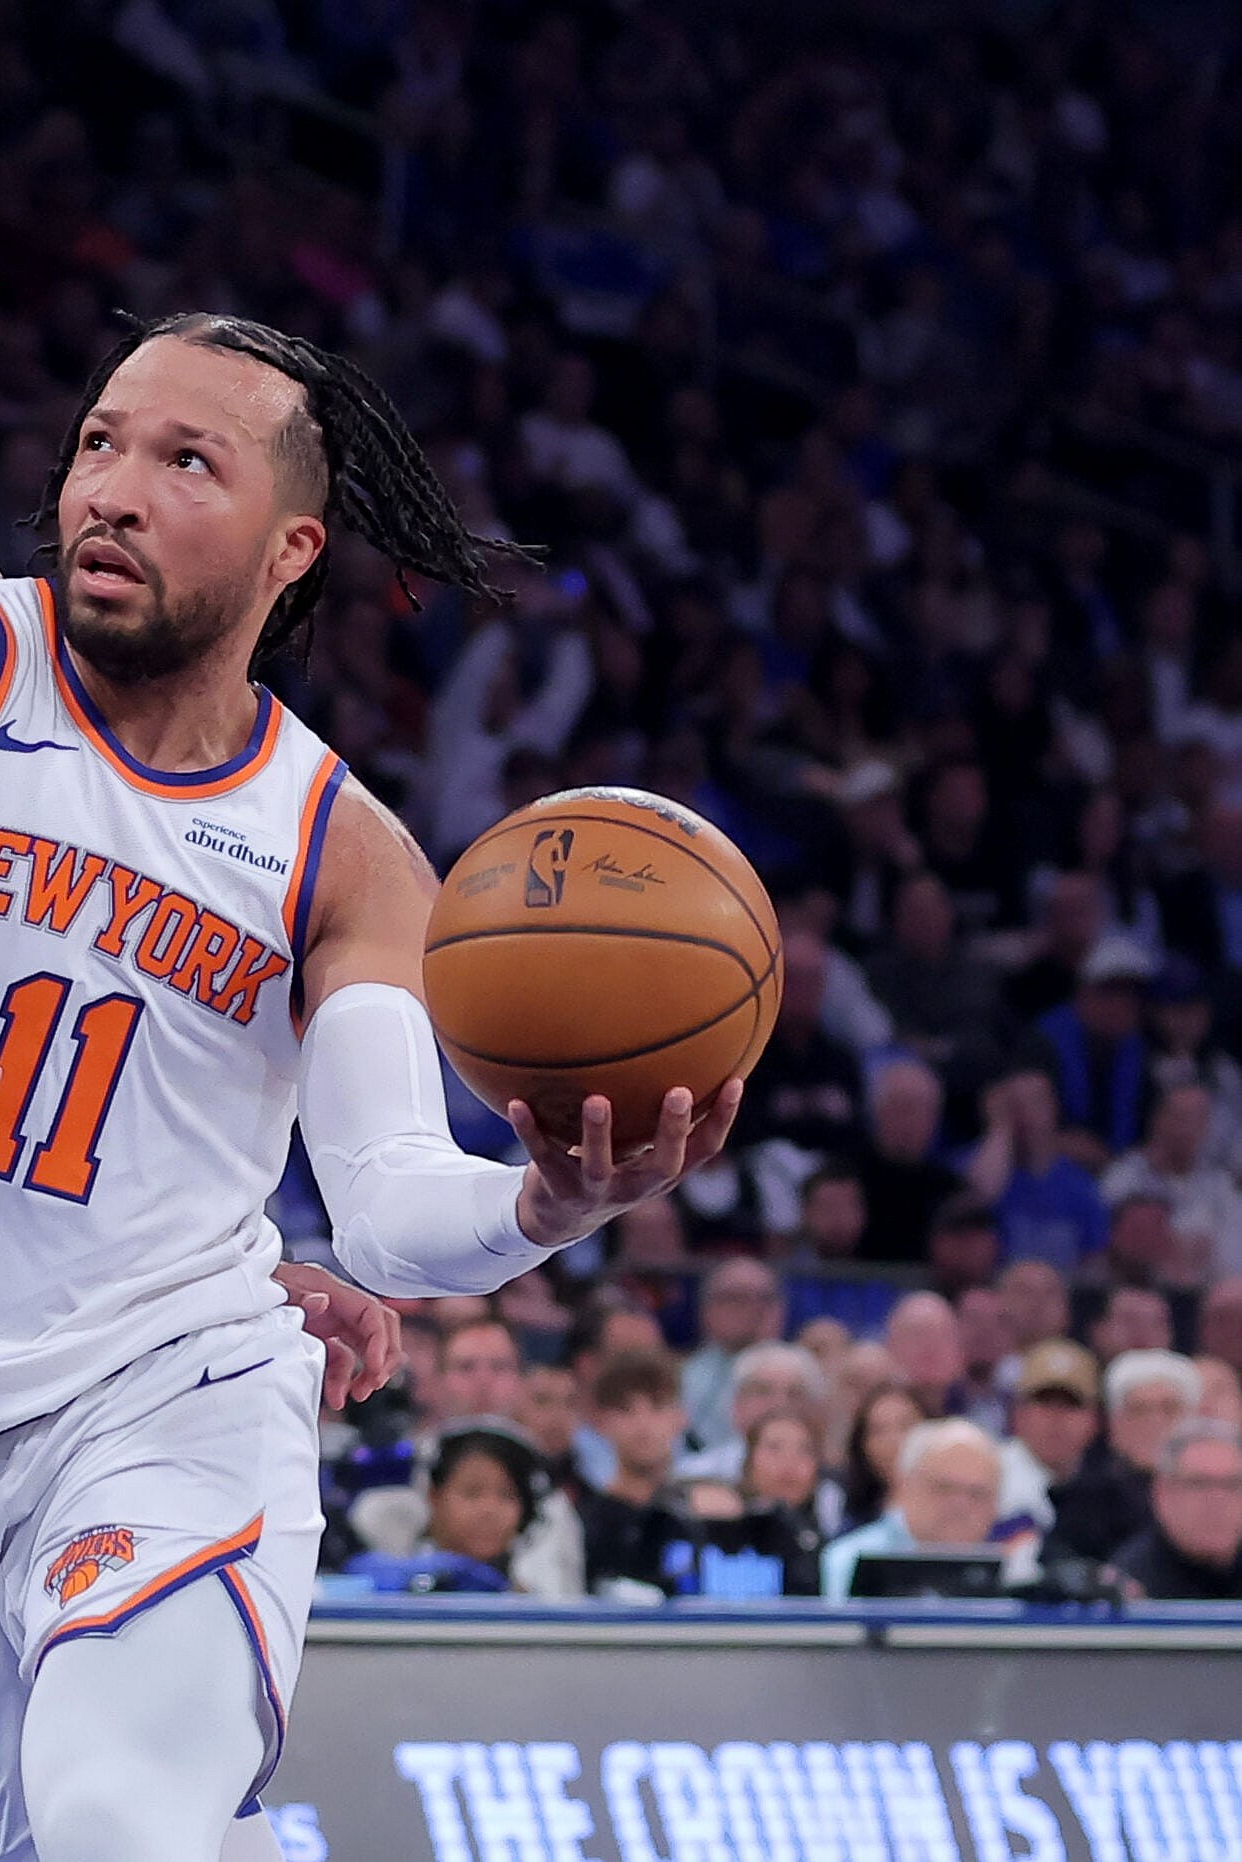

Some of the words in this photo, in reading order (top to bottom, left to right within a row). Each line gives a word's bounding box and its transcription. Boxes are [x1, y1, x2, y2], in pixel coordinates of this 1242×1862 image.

[184, 830, 226, 853] abu
[228, 843, 289, 875] dhabi
[191, 817, 247, 842] experience
[95, 863, 291, 1026] YORK
[393, 1741, 600, 1862] THE
[600, 1740, 960, 1862] CROWN
[949, 1740, 1067, 1862] IS
[1045, 1740, 1242, 1862] YOU
